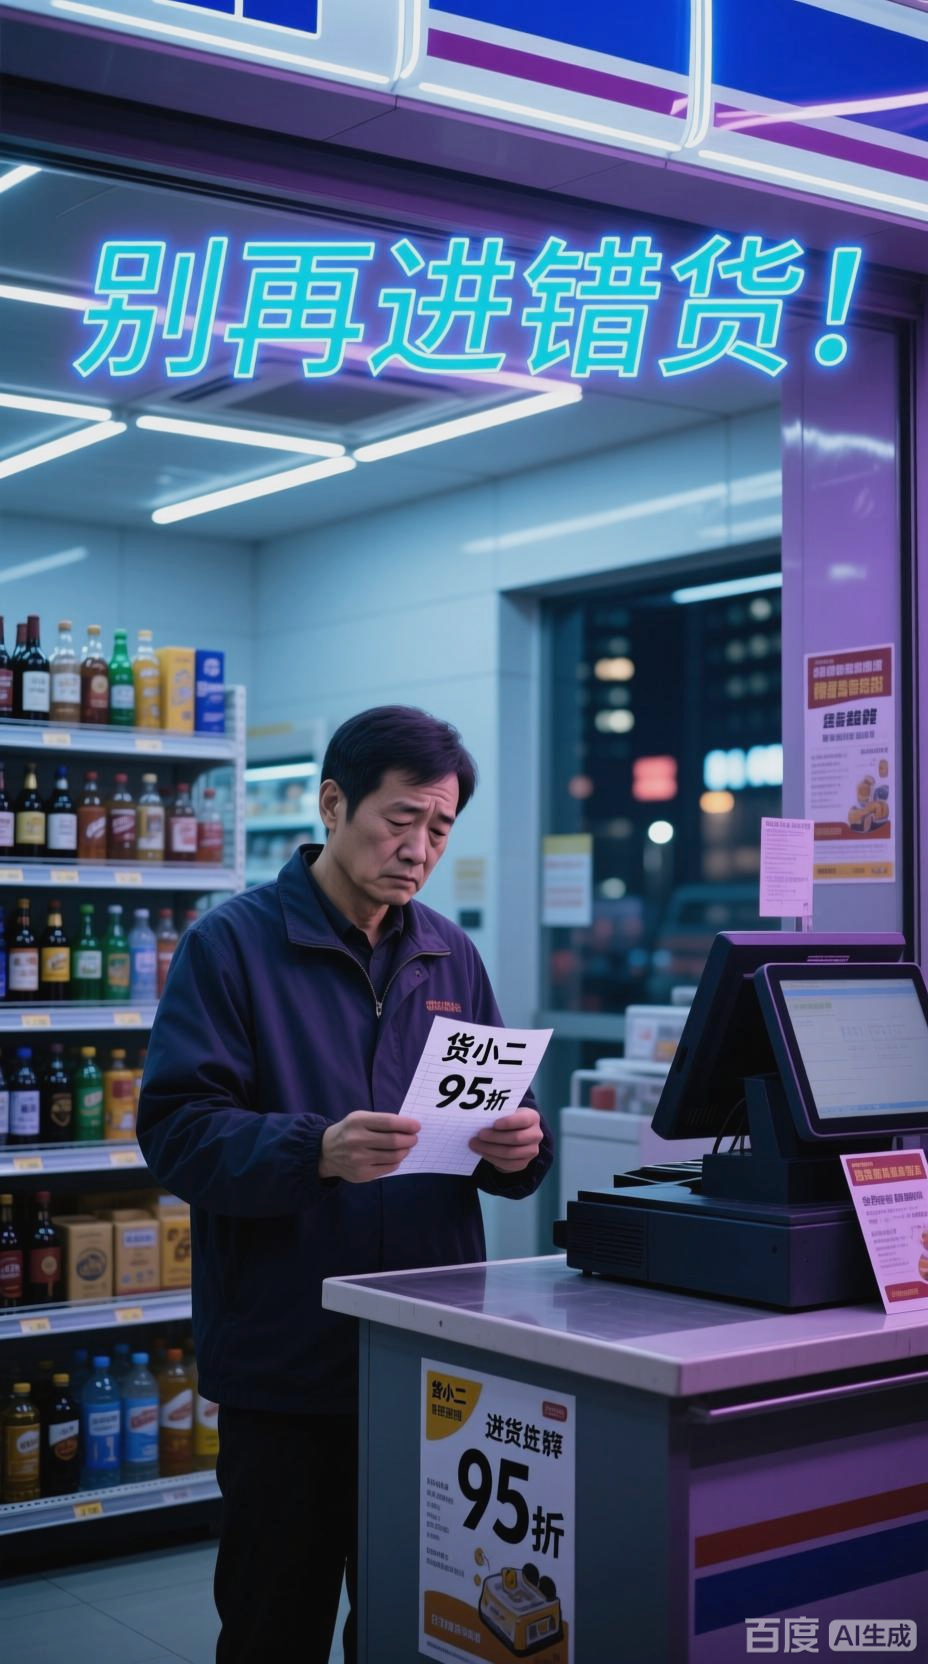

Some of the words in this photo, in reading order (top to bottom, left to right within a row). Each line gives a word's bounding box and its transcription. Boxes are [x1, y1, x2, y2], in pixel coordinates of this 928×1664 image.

[73, 235, 862, 378] 别再进错货！
[442, 1032, 526, 1066] 货小二
[436, 1074, 511, 1111] 95折
[458, 1448, 564, 1559] 95折
